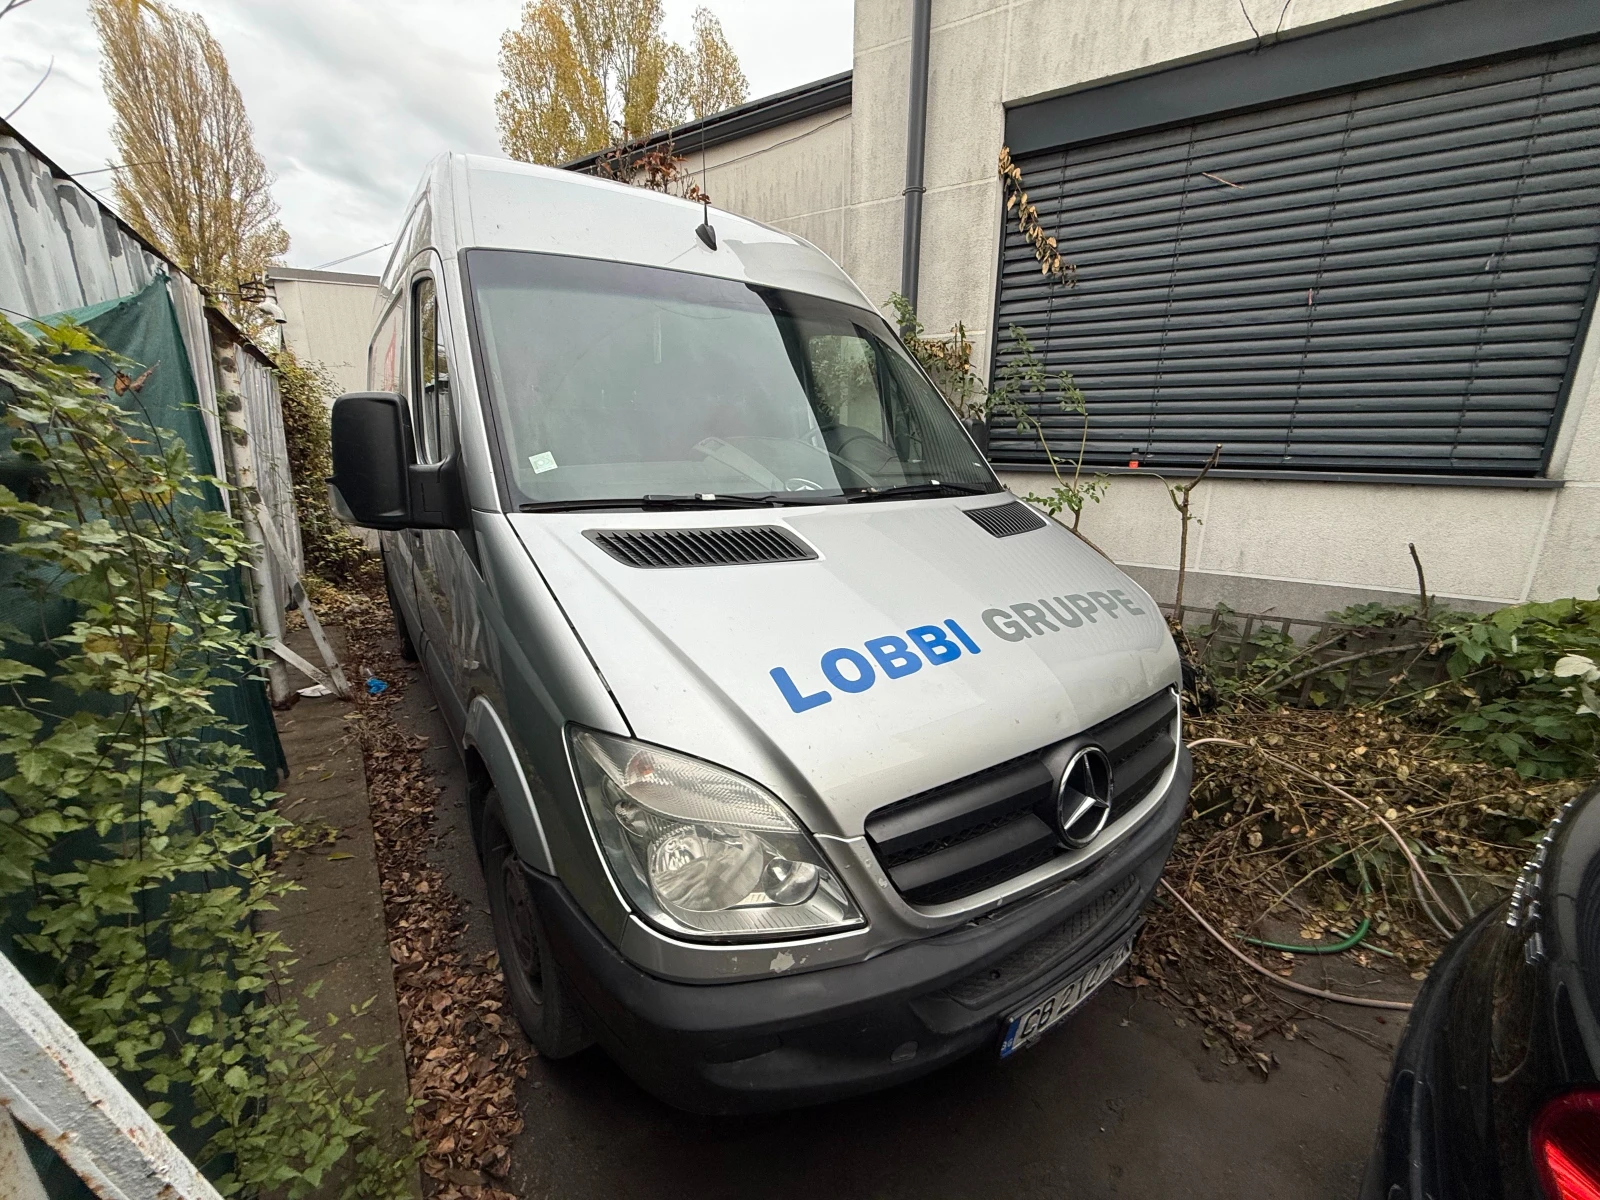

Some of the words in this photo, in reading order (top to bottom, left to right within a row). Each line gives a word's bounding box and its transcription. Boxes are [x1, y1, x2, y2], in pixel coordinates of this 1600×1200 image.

[770, 618, 981, 714] LOBBI
[981, 589, 1146, 643] GRUPPE
[1020, 995, 1056, 1039] CB
